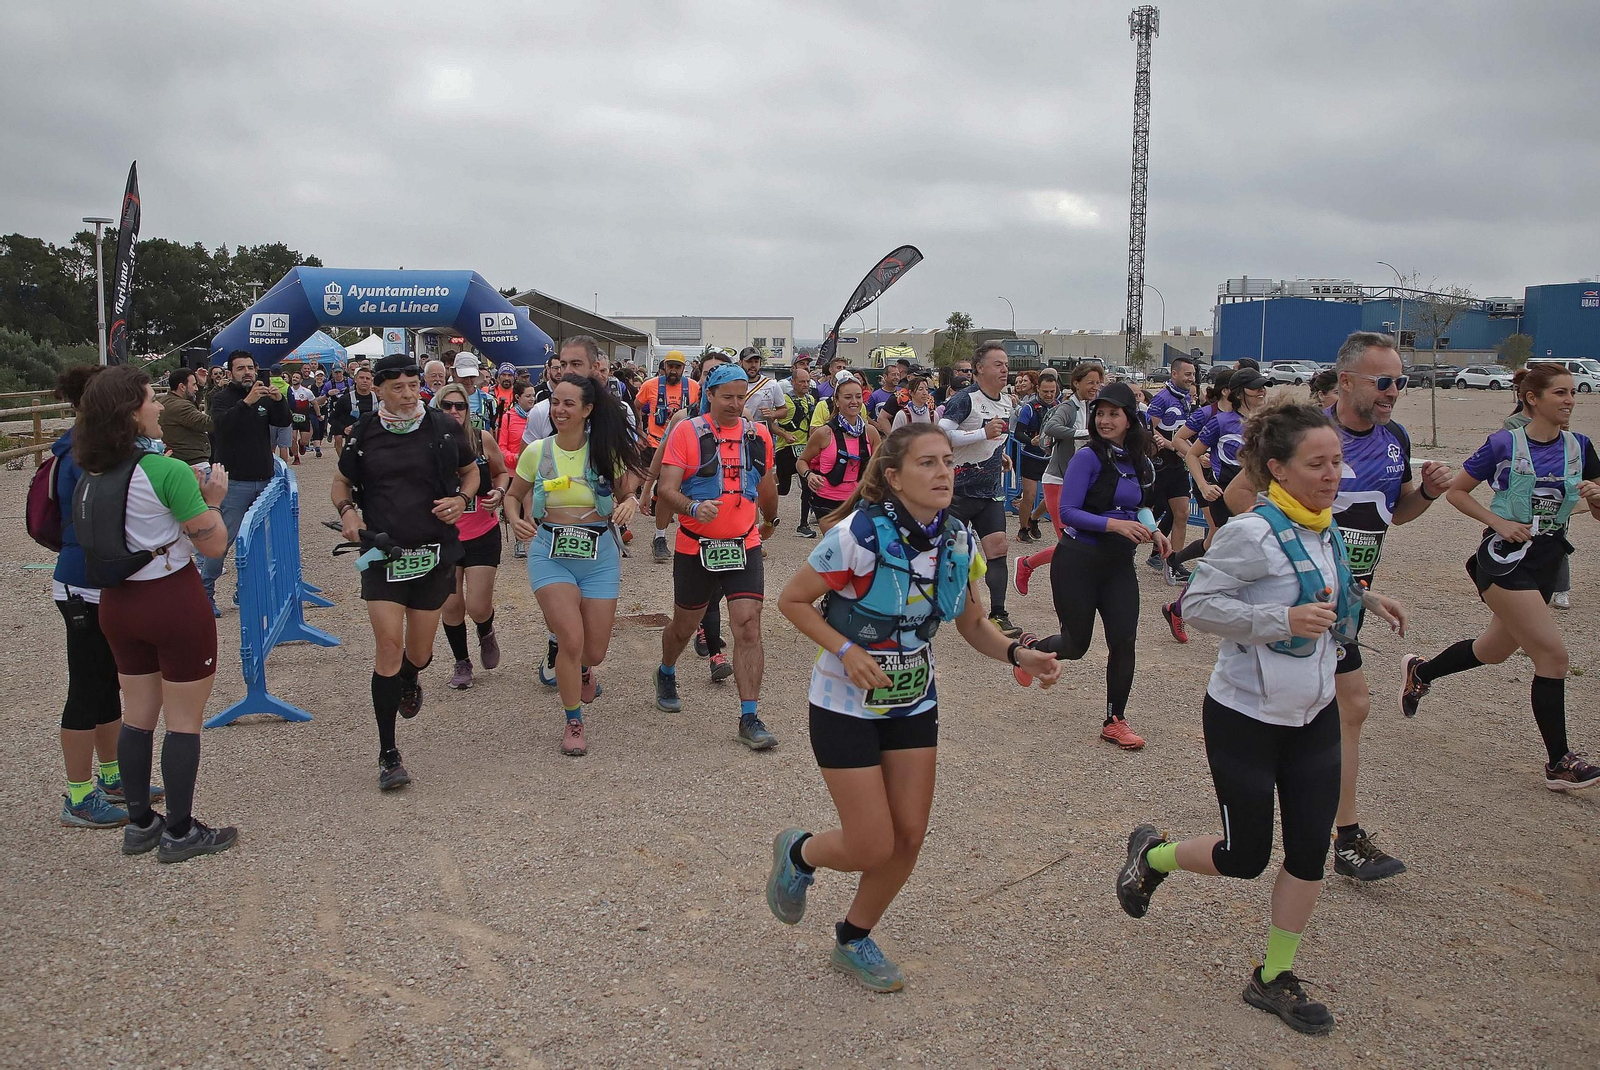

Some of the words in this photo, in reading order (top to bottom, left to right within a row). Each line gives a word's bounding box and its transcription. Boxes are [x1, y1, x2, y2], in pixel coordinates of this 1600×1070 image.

[347, 285, 450, 300] Ayuntamiento
[359, 301, 377, 313] de
[380, 301, 397, 313] La
[400, 300, 439, 313] Línea
[254, 317, 265, 328] D
[485, 317, 495, 328] D
[482, 335, 519, 343] DEPORTES
[1343, 530, 1360, 540] XIII
[557, 537, 591, 552] 293
[1343, 538, 1378, 546] ARBONERA
[708, 548, 741, 561] 428
[396, 555, 431, 571] 355
